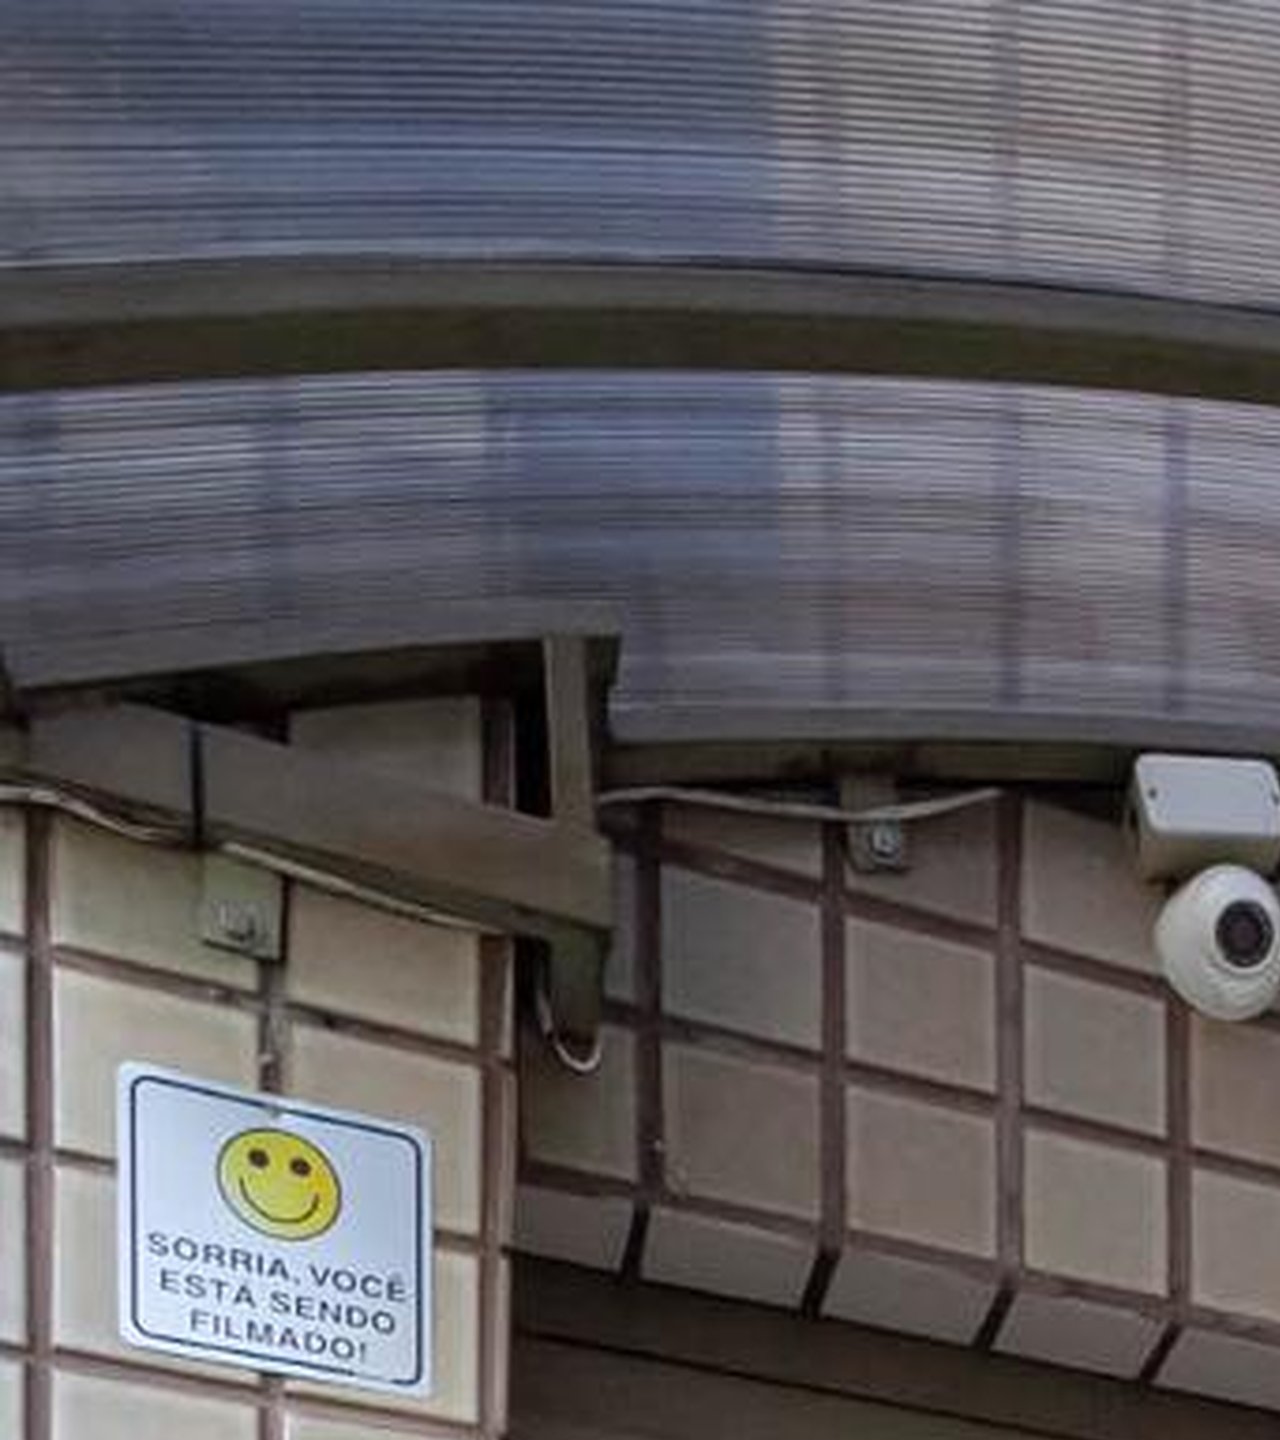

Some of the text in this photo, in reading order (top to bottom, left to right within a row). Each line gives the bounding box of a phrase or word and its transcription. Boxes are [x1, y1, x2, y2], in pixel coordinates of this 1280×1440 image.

[148, 1231, 300, 1286] SORRIA,
[190, 1309, 366, 1364] FILMADO!
[269, 1290, 396, 1336] SENDO
